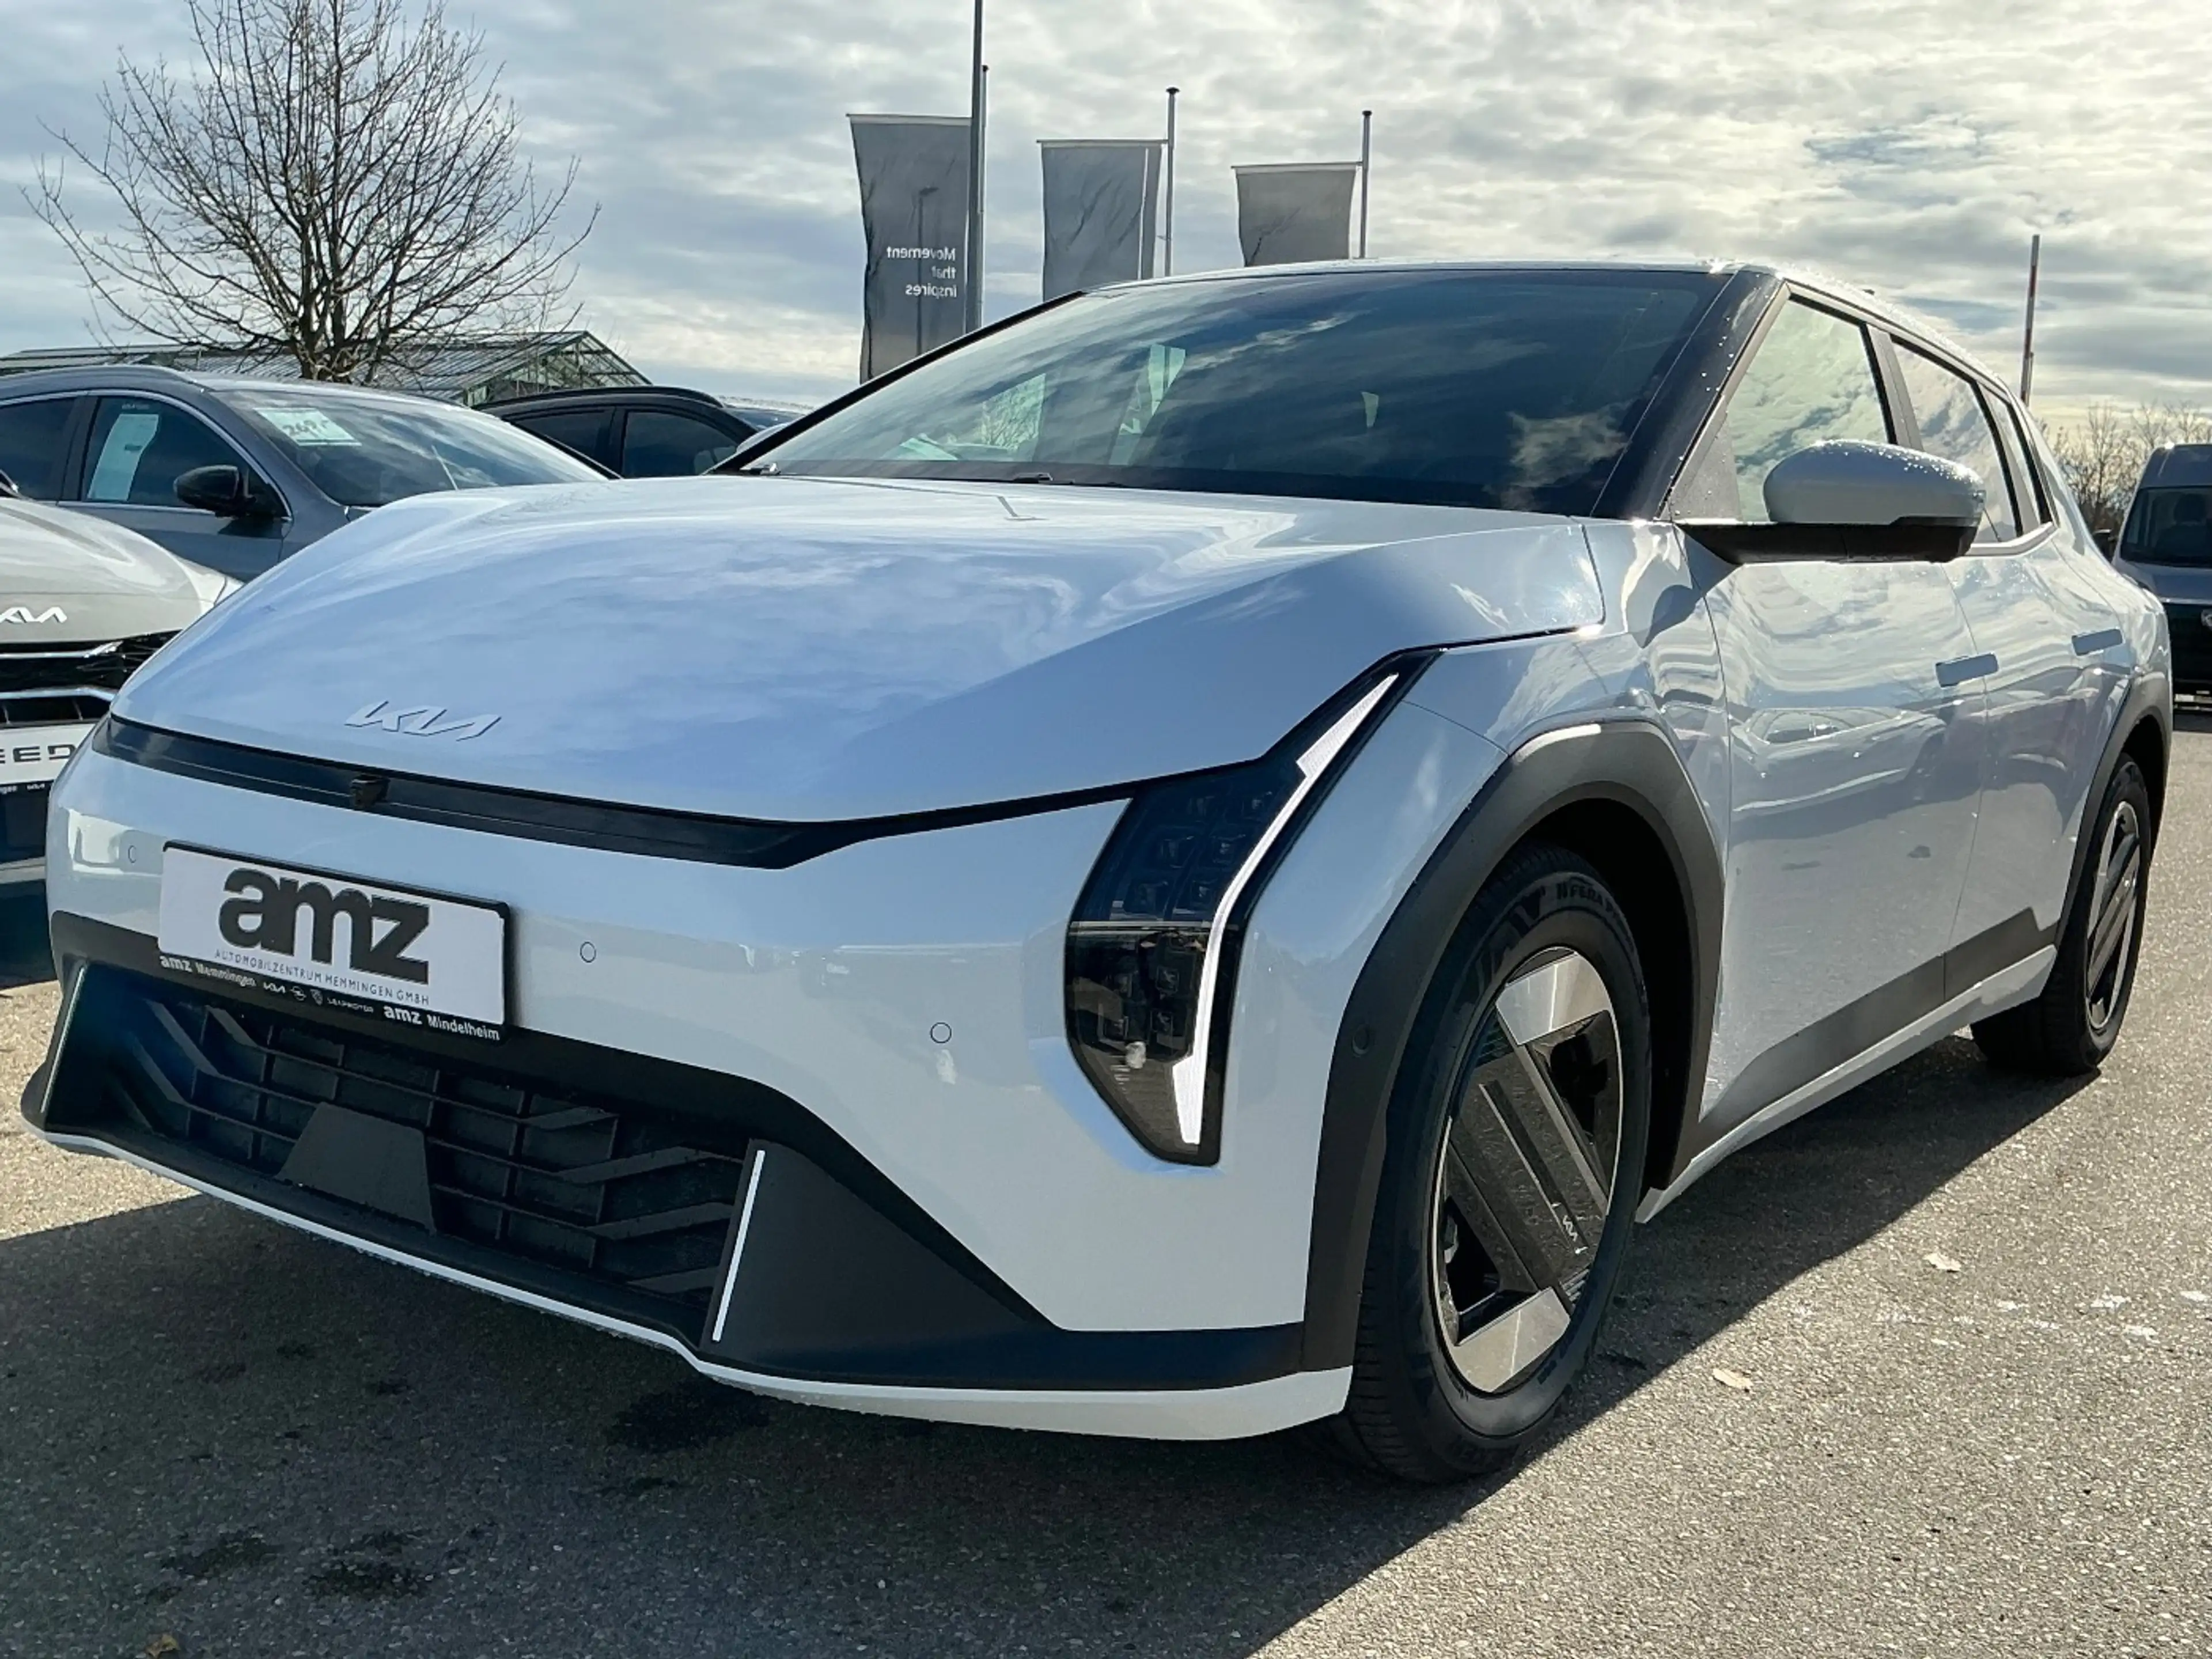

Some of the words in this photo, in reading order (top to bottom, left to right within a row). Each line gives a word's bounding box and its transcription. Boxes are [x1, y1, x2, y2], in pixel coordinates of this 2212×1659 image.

[344, 699, 502, 741] KIA
[219, 868, 429, 984] amz
[214, 949, 322, 983] AUTOMOBILZENTRUM
[160, 956, 192, 972] amz
[195, 962, 257, 987] Memmingen
[383, 1005, 423, 1025] amz
[426, 1014, 500, 1041] Mindelheim
